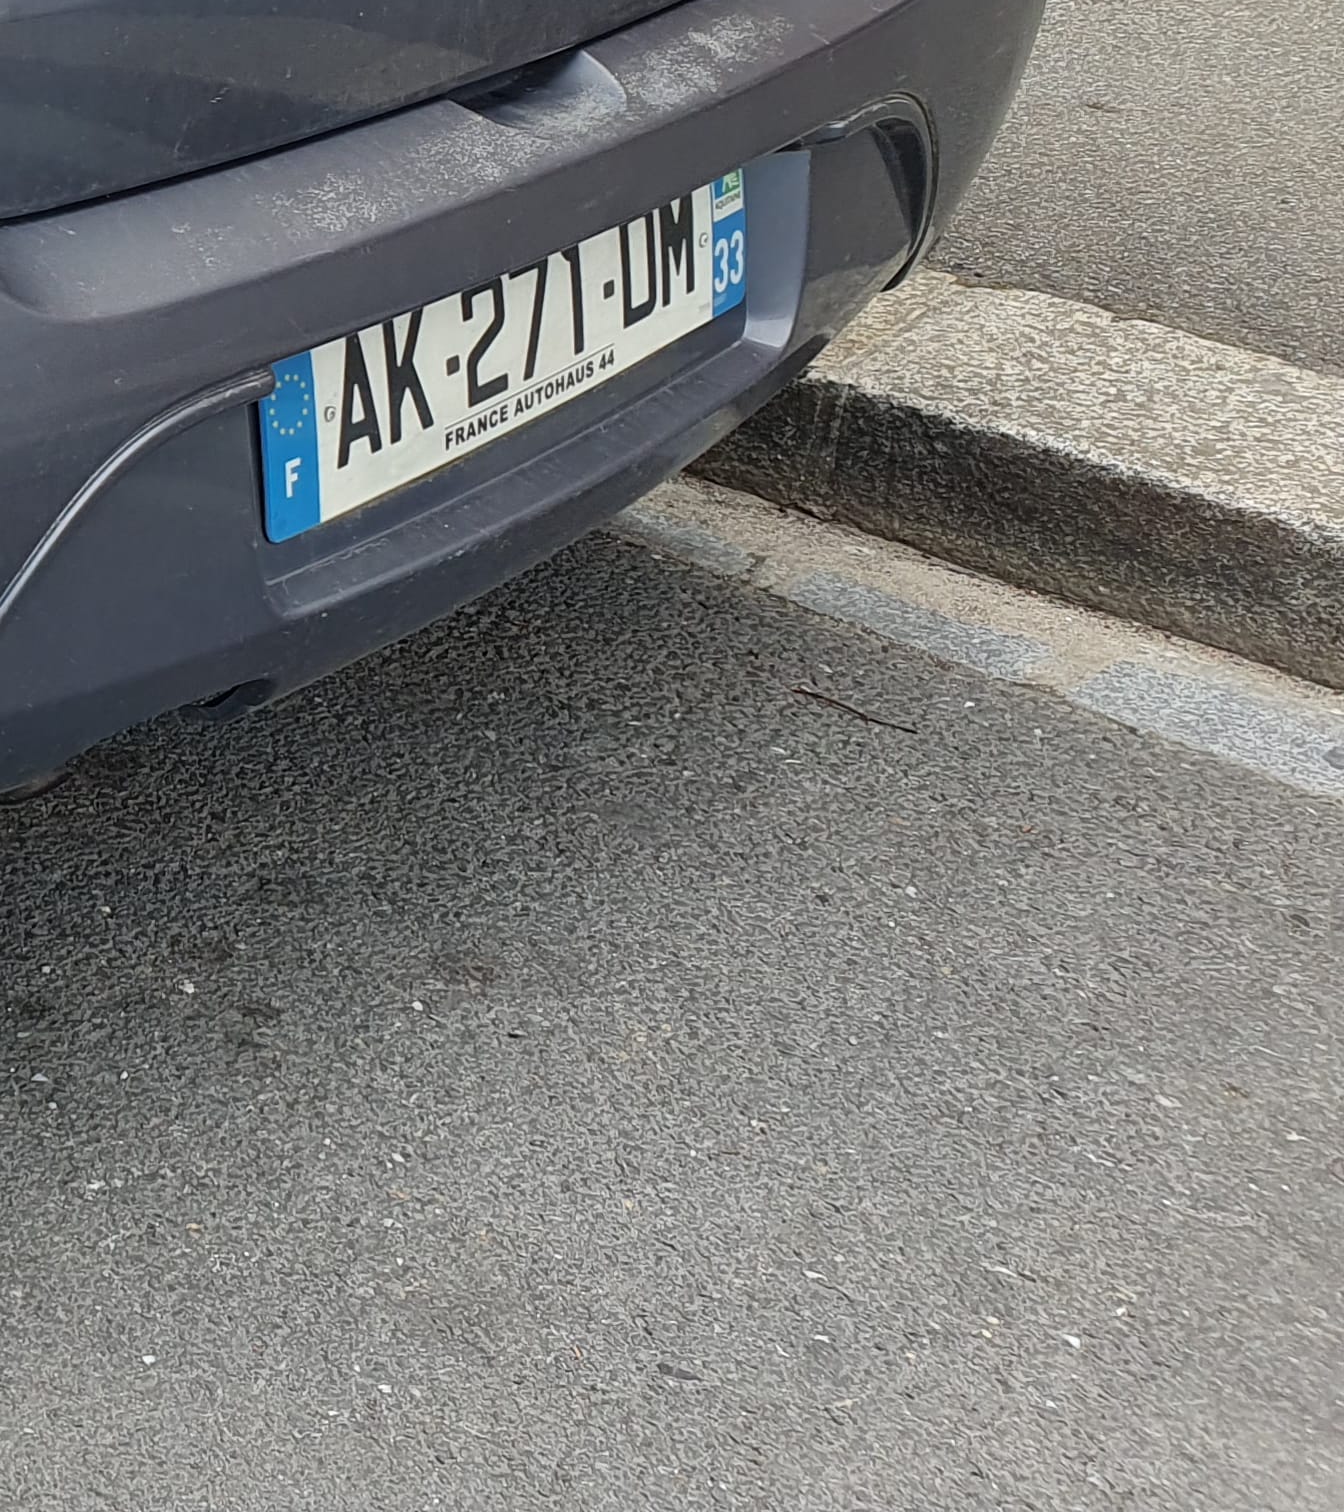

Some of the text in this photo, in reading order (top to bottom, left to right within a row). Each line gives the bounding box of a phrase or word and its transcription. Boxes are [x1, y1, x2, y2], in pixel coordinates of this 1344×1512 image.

[714, 230, 744, 293] 33
[337, 191, 695, 469] AK-271-DM
[445, 349, 615, 451] FRANCE AUTOHAUS 44
[285, 458, 301, 498] F
